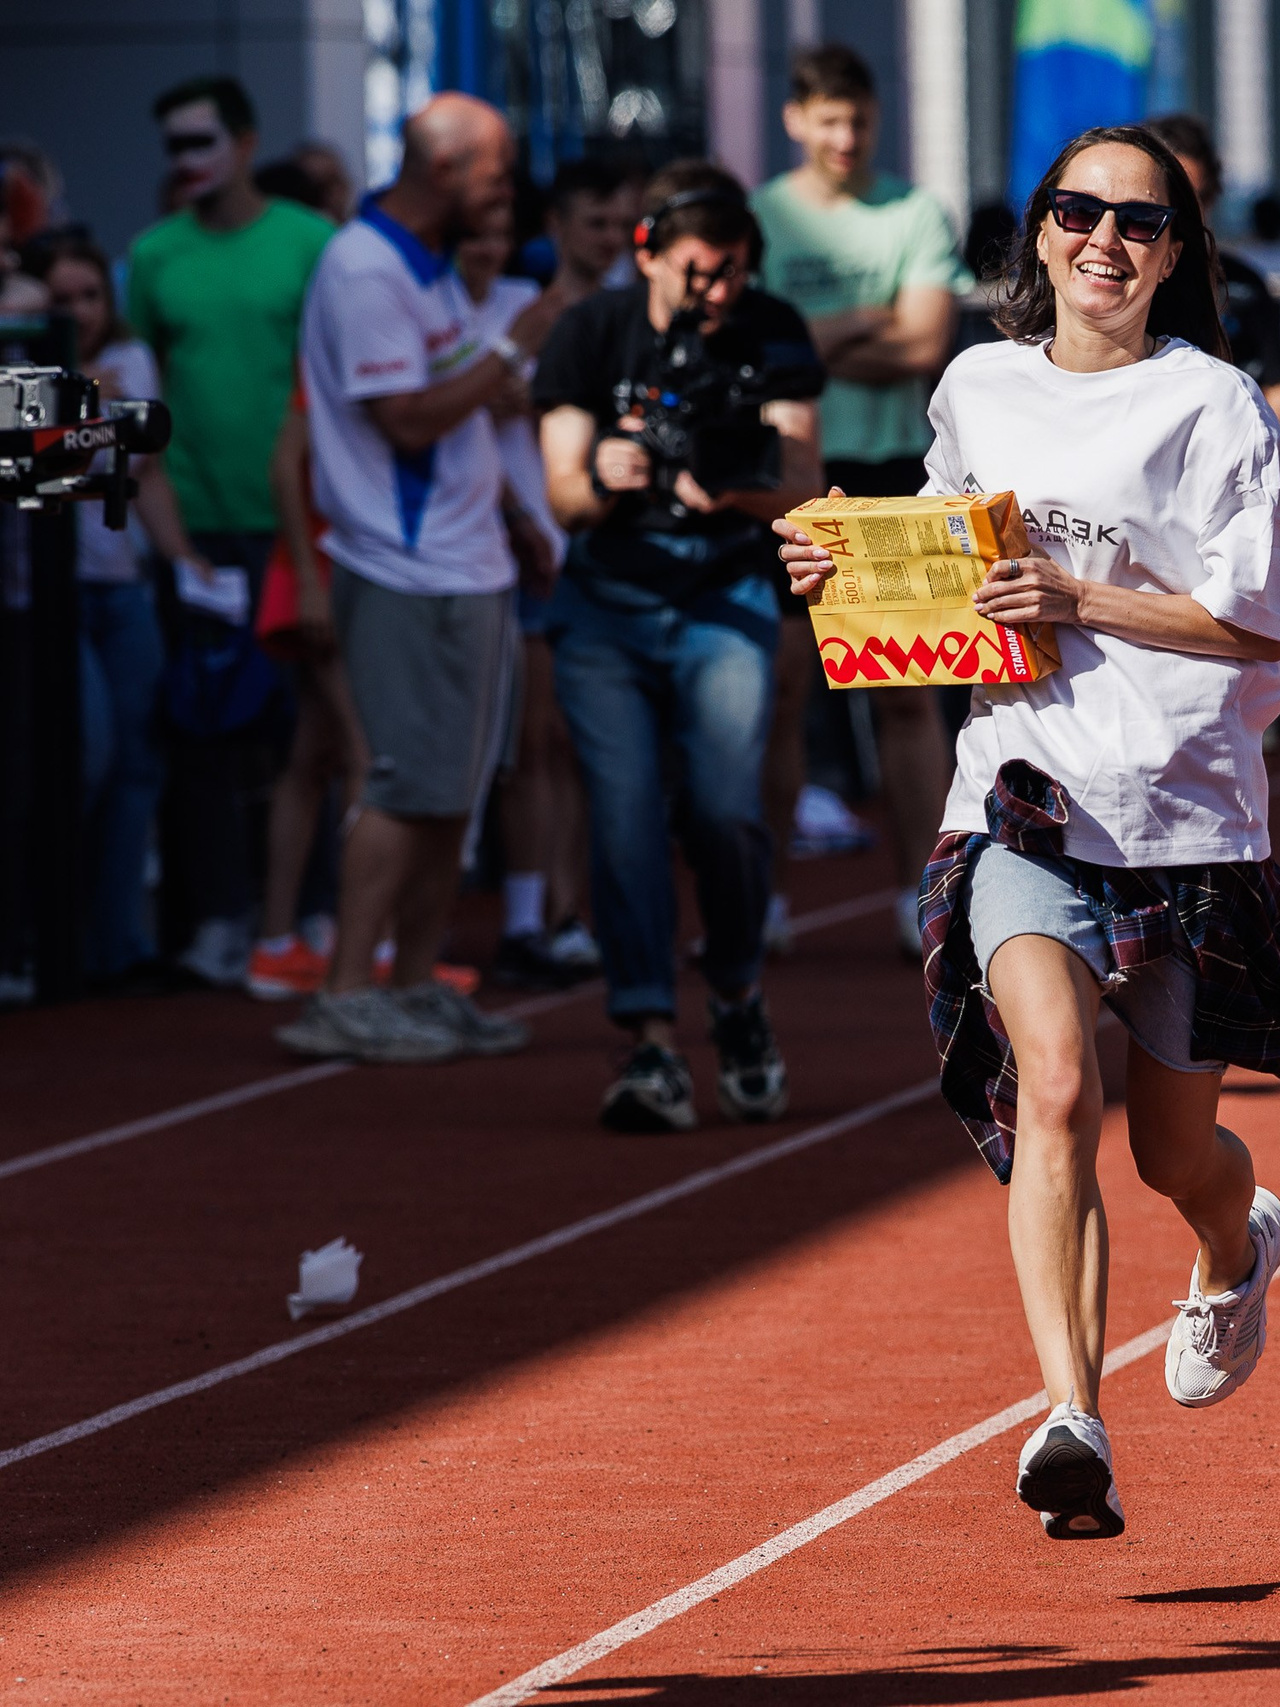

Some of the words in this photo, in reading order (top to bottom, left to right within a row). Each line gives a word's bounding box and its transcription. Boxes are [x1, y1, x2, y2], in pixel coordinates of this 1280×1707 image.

[63, 425, 116, 450] RONIN
[811, 518, 855, 557] A4
[1021, 508, 1120, 546] АДЭК
[844, 581, 861, 604] 500
